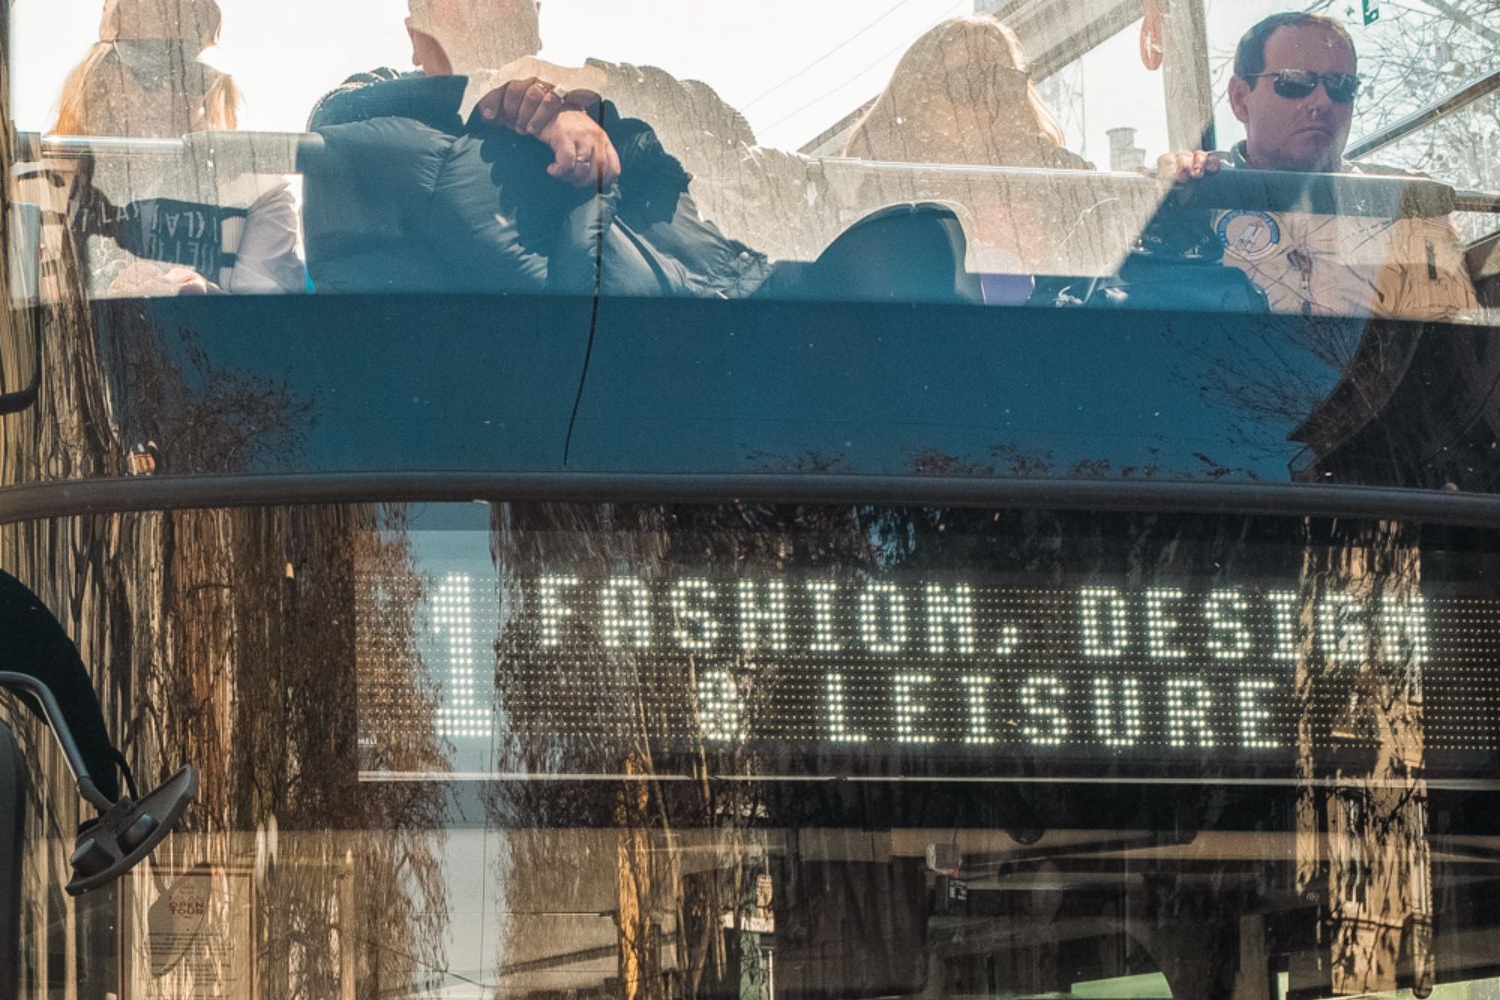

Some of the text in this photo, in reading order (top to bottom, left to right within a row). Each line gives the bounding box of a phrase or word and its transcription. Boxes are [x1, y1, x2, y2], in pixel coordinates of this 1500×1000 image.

[433, 573, 492, 738] 1
[539, 573, 1431, 663] FASHION, DESIGN
[825, 672, 1278, 748] LEISURE
